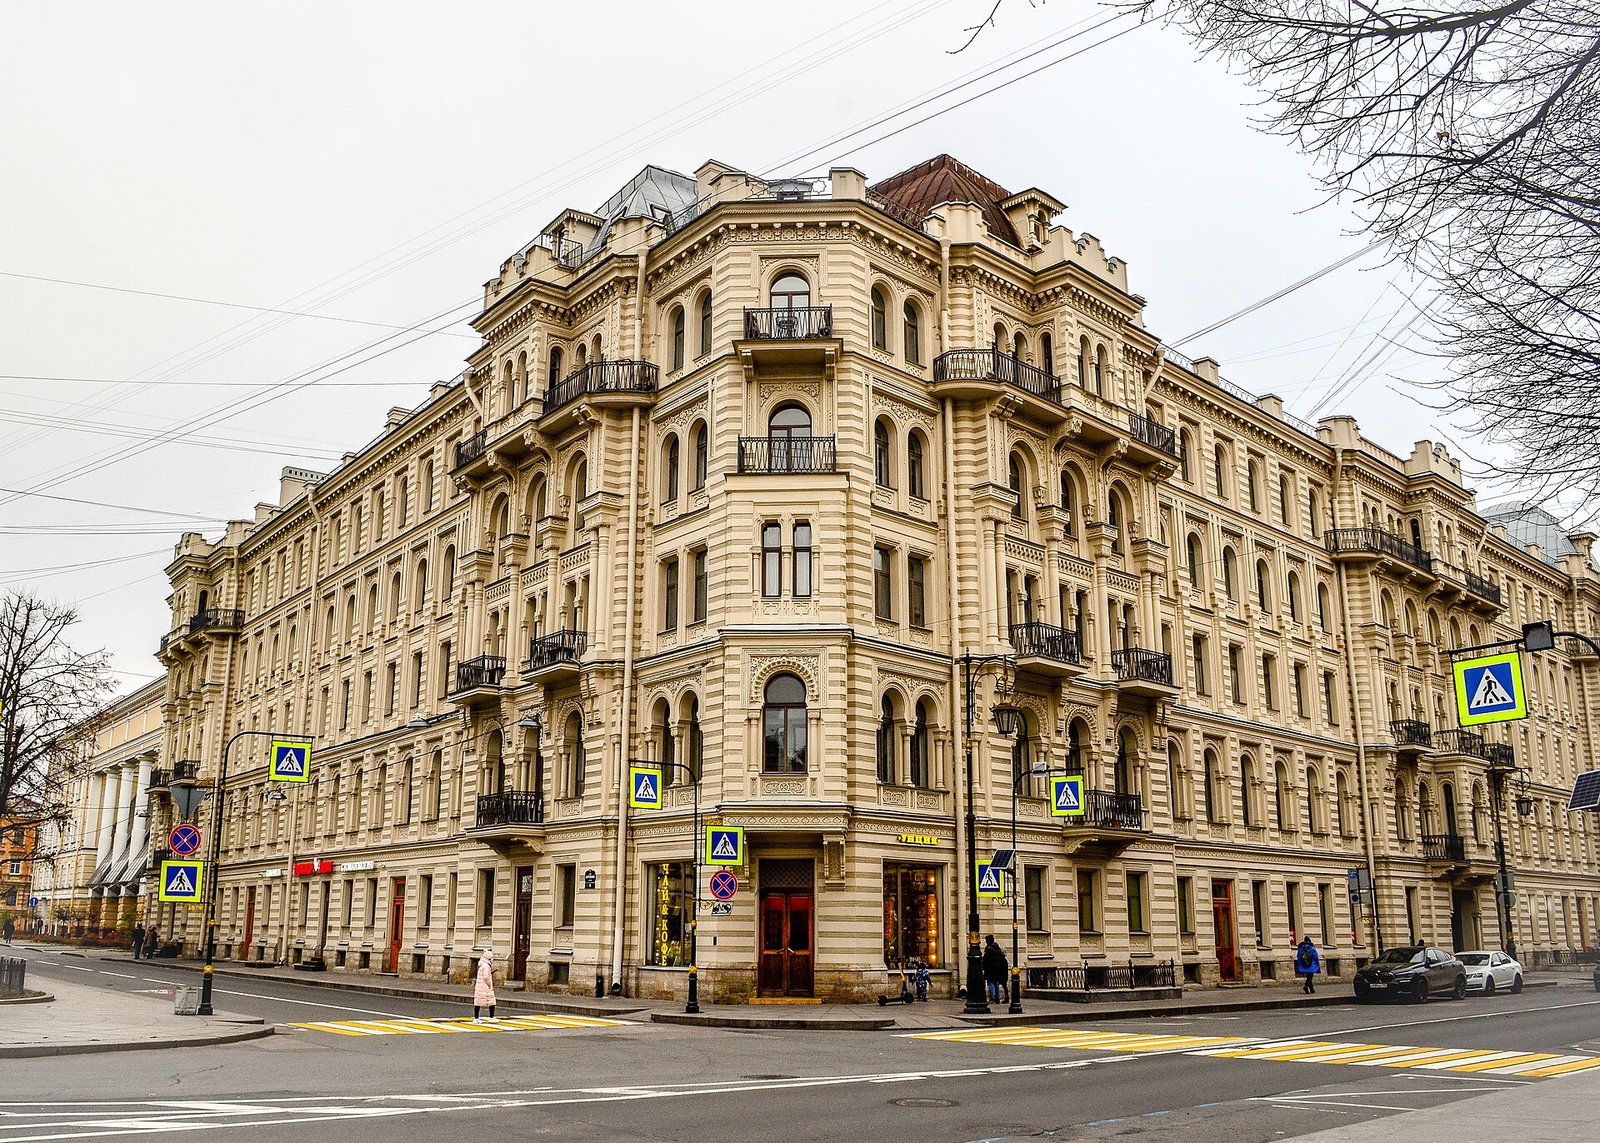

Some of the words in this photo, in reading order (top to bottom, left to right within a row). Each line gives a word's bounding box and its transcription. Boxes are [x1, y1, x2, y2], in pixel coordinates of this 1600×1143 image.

[661, 863, 670, 900] ЧАЙ
[661, 904, 669, 915] &
[660, 919, 669, 967] КОФЕ
